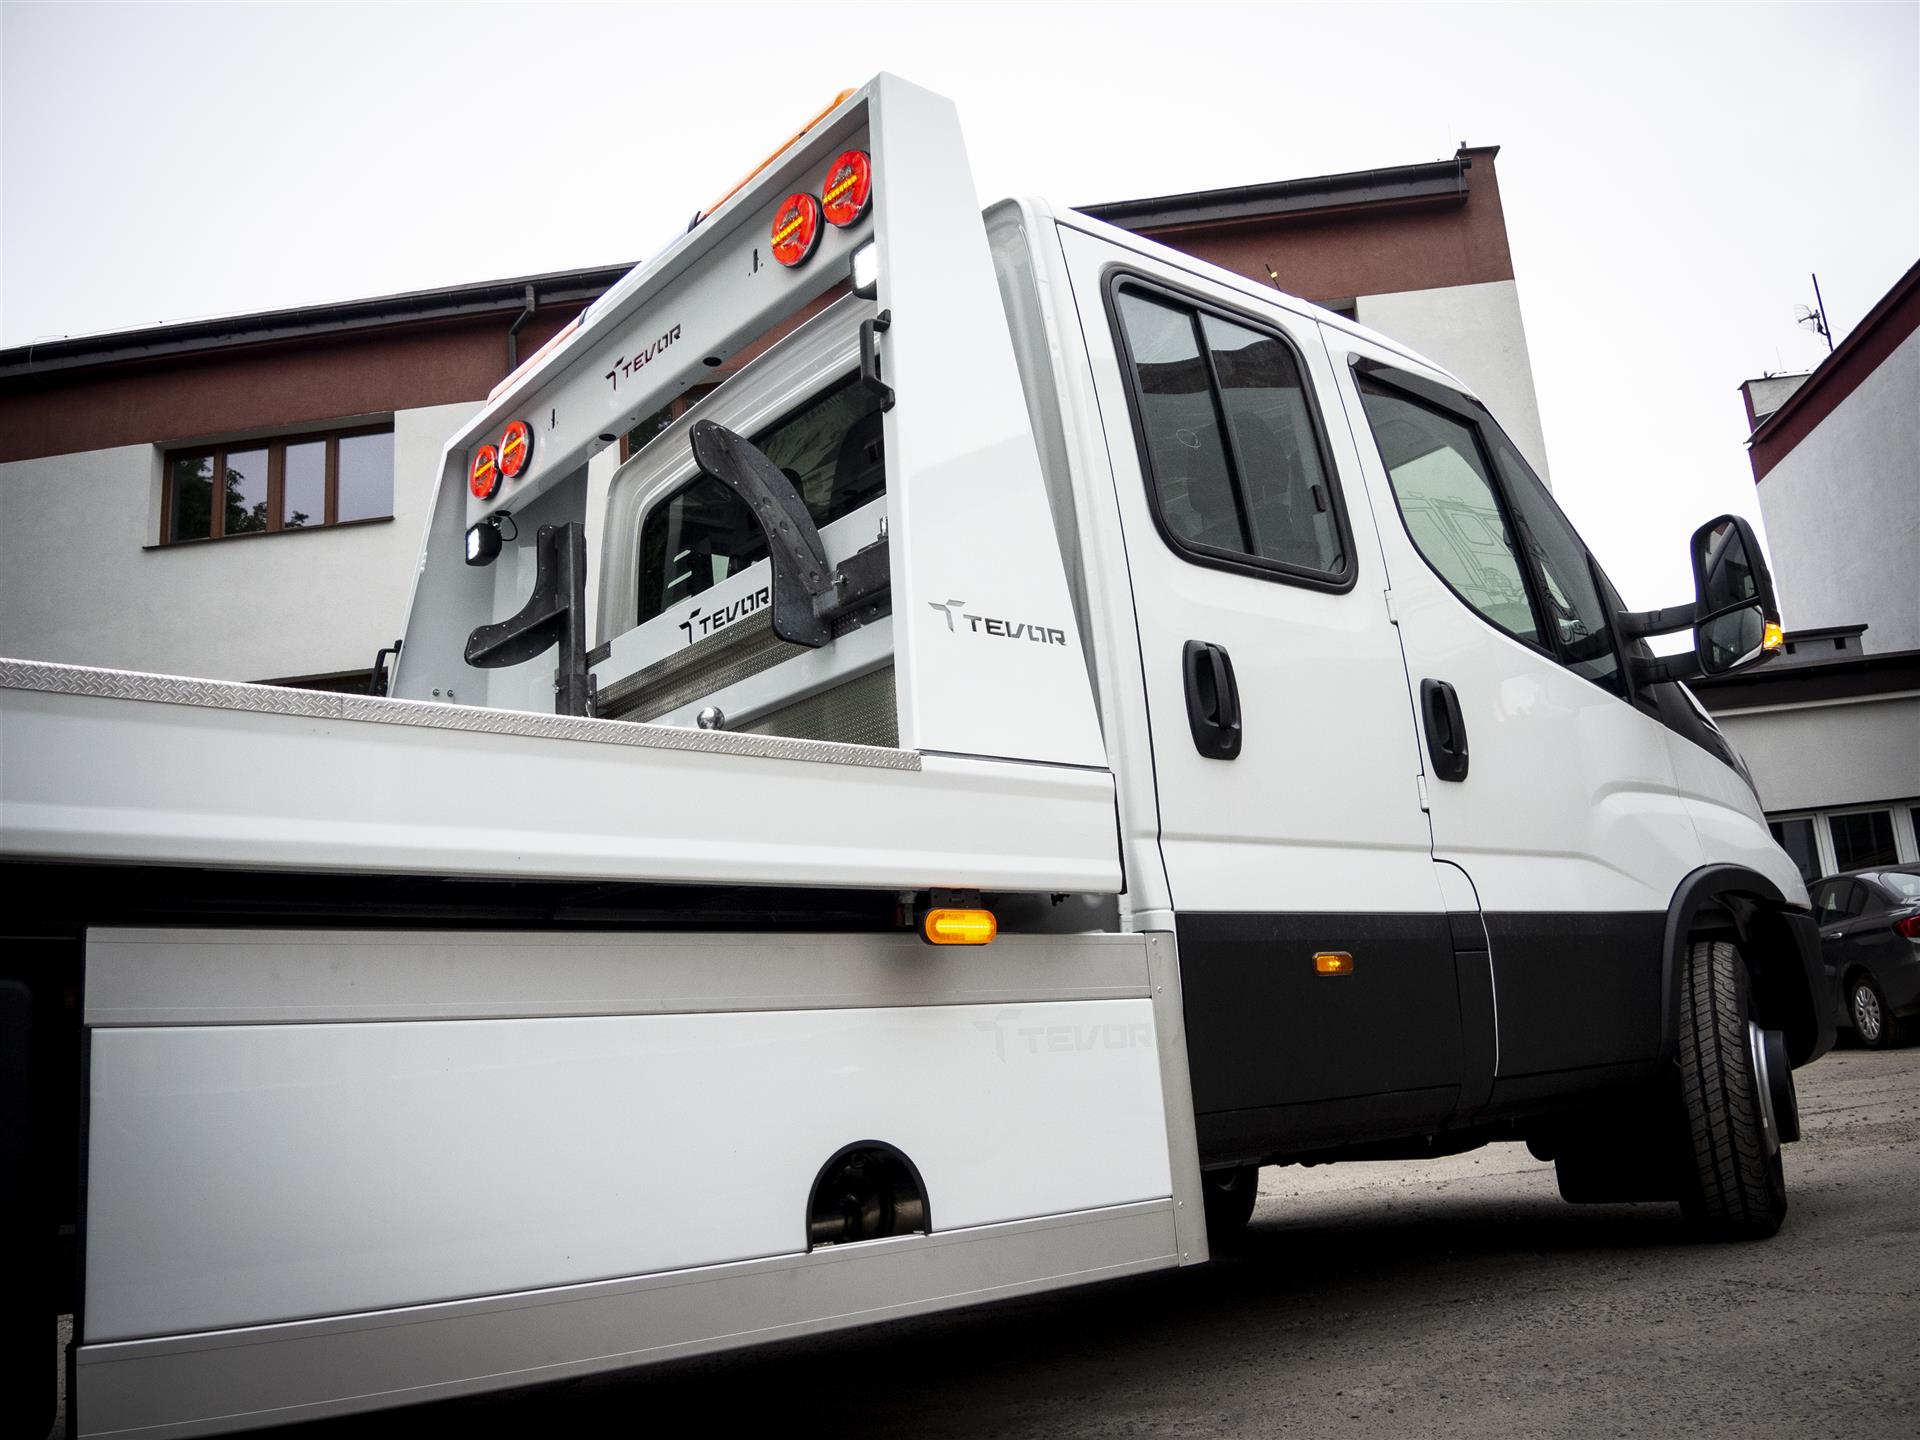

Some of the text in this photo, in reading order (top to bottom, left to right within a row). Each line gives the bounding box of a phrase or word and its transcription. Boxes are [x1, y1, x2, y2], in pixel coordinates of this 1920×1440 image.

[622, 323, 681, 378] TEVOR
[699, 586, 769, 635] TEVOR
[963, 613, 1067, 646] TEVOR
[1018, 1024, 1153, 1054] TEVOR
